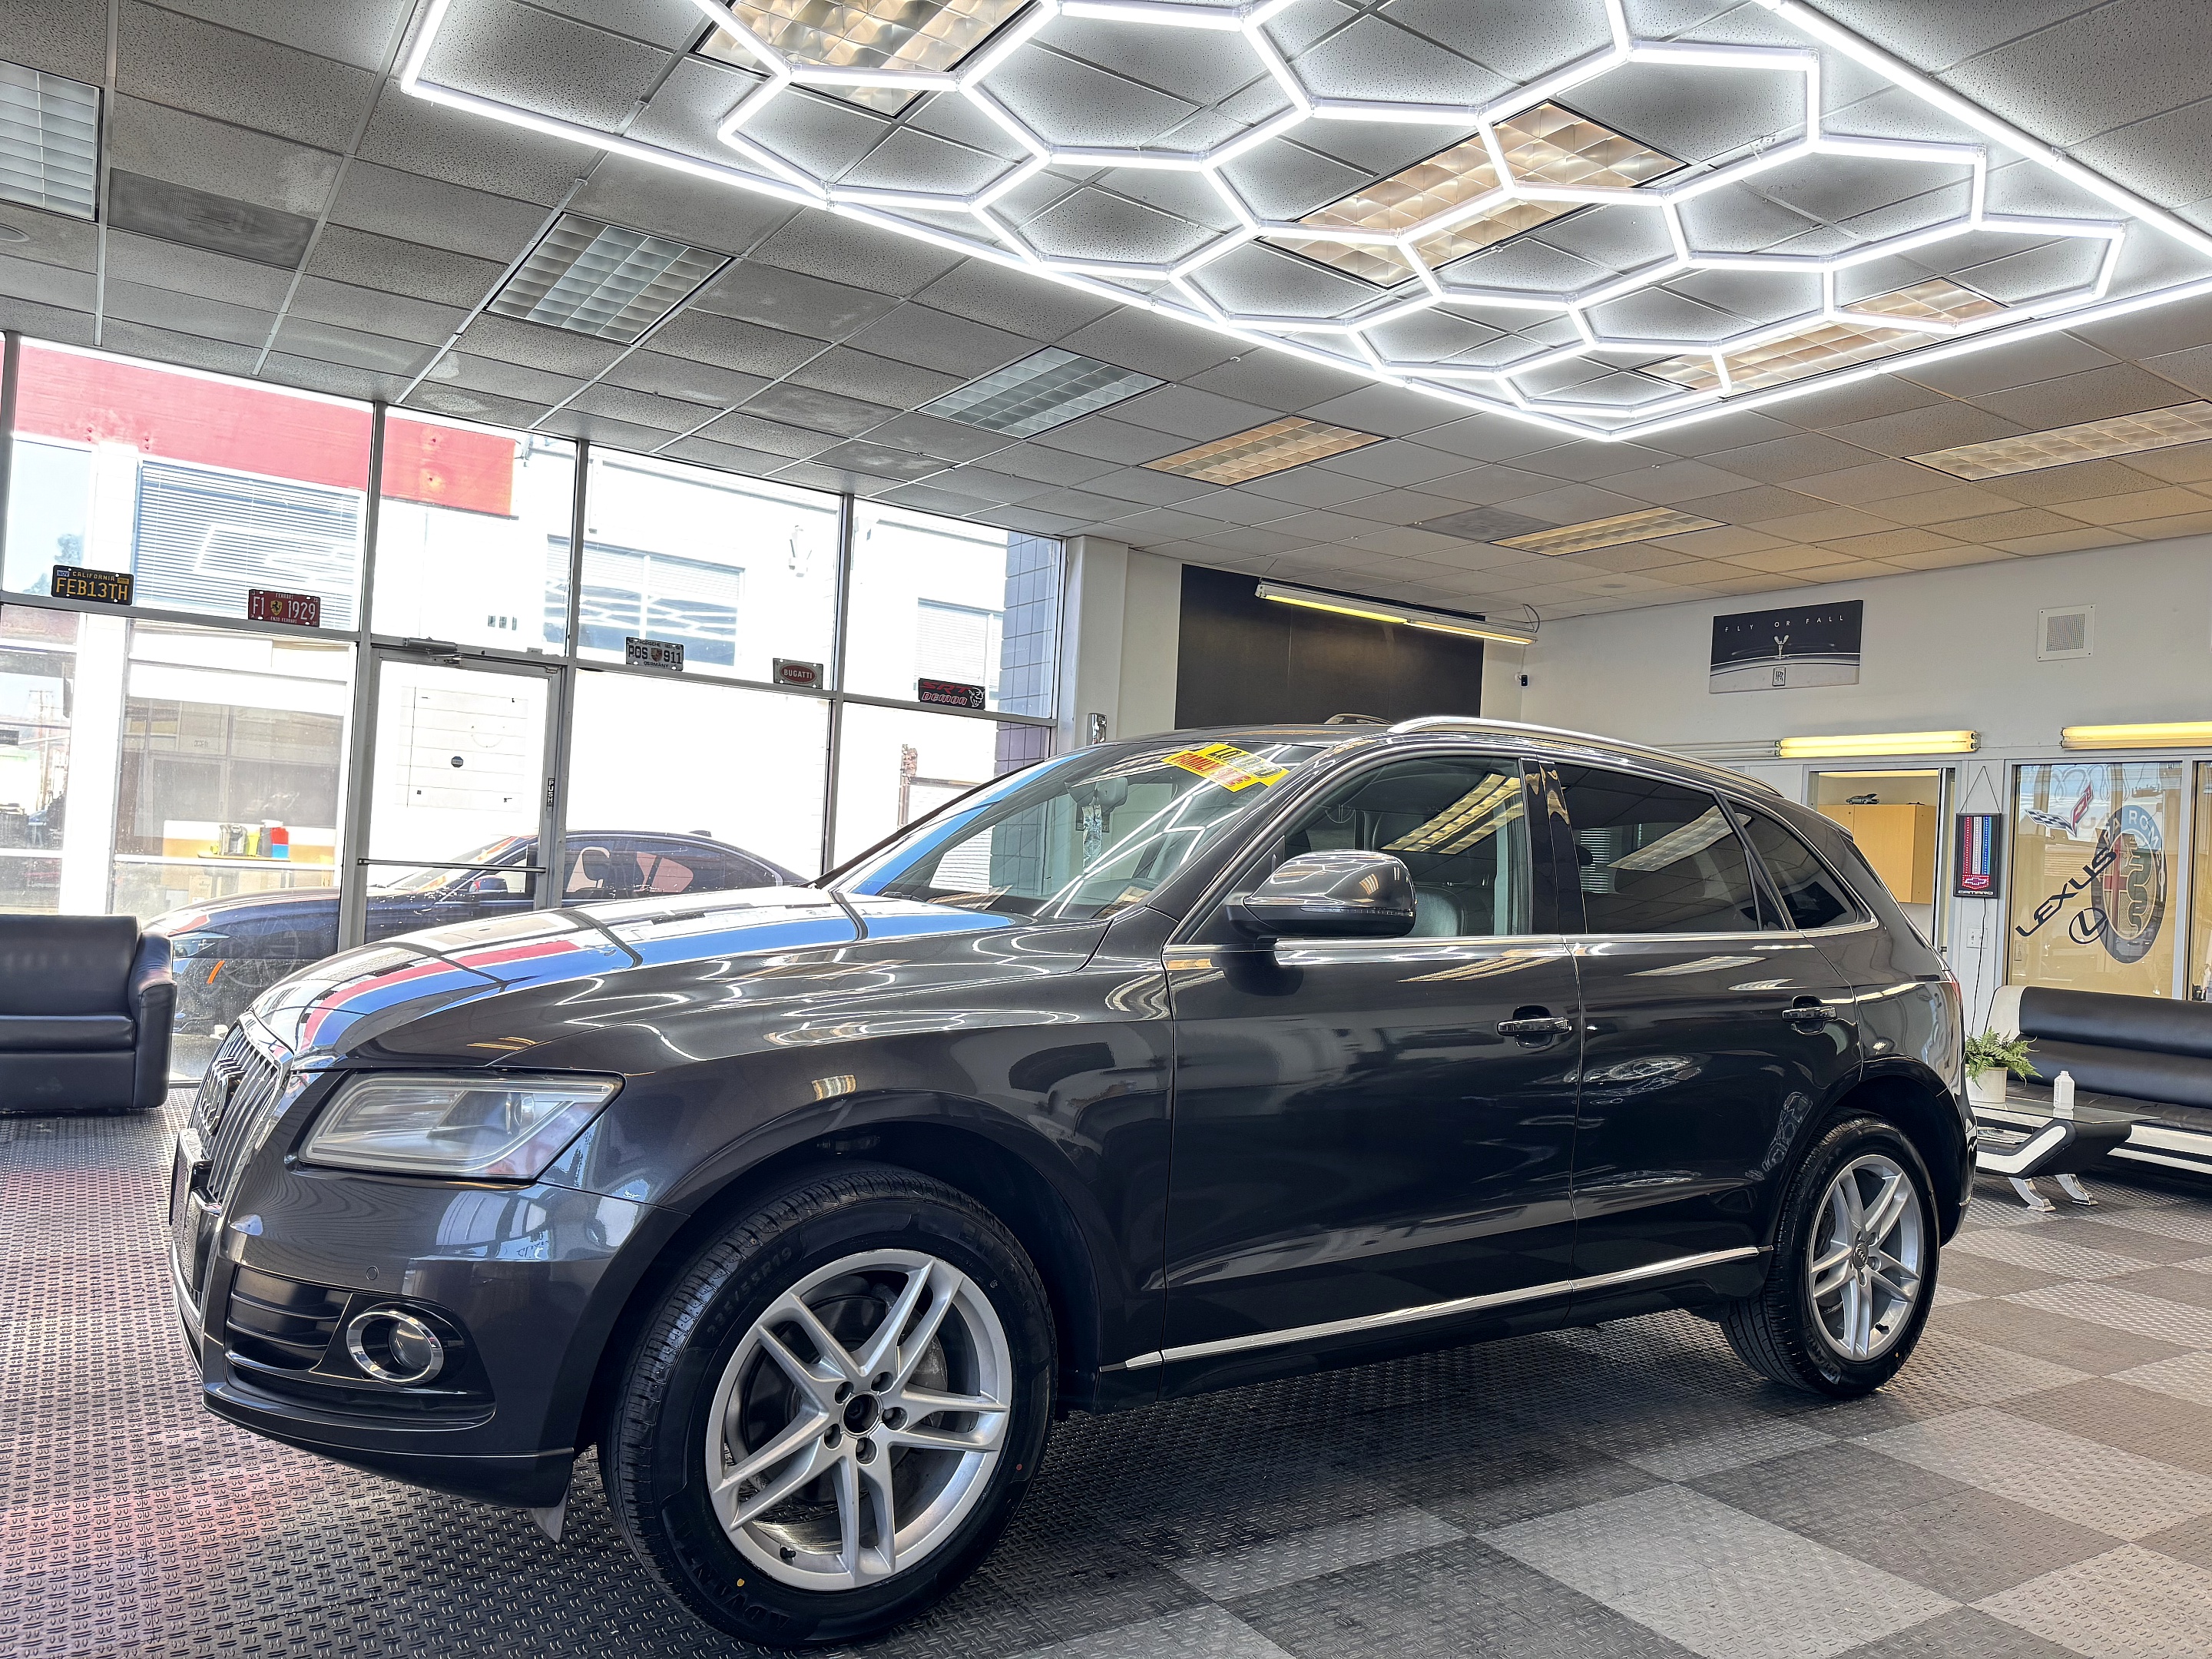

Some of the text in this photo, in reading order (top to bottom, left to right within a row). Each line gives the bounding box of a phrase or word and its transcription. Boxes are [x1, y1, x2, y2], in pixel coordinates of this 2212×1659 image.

[72, 571, 115, 581] CALIFORNIA
[55, 578, 128, 601] FEB13TH
[253, 596, 316, 621] F1 1929
[1724, 624, 1754, 633] FLY
[1806, 614, 1844, 624] FALL
[628, 644, 683, 664] POS 911
[643, 661, 669, 669] GERMANY
[783, 668, 813, 679] BUGATTI
[919, 681, 972, 695] SRT
[921, 691, 968, 706] DEMON
[1171, 752, 1224, 773] FAMILY
[2015, 846, 2118, 938] LEXUS
